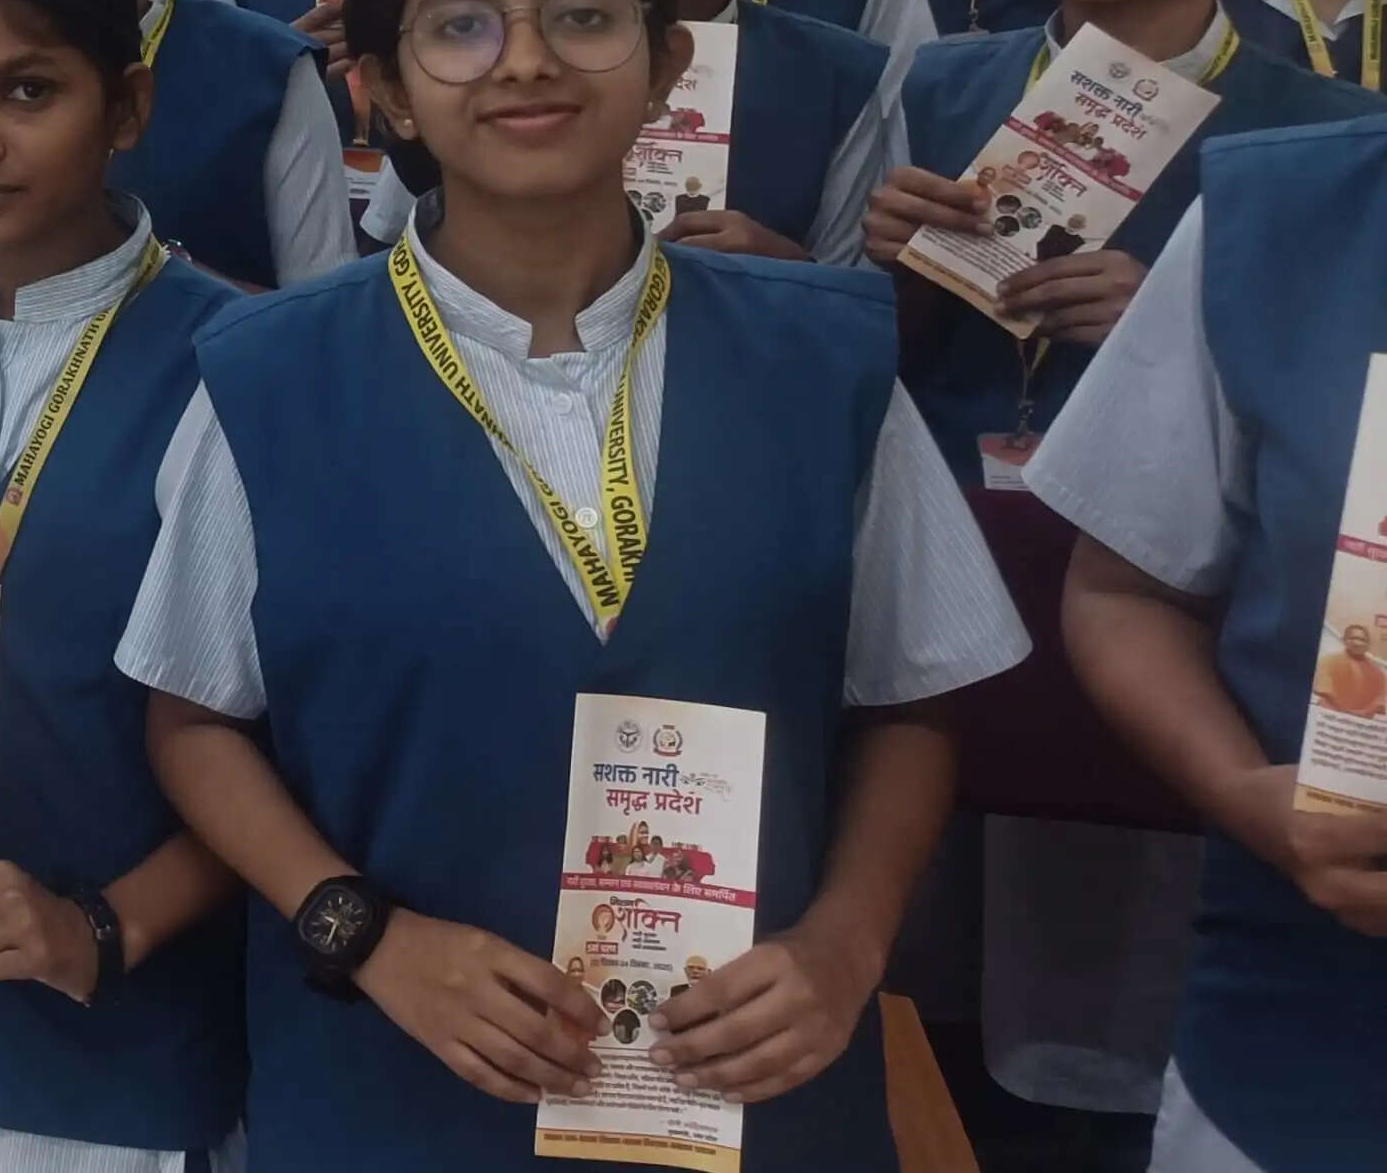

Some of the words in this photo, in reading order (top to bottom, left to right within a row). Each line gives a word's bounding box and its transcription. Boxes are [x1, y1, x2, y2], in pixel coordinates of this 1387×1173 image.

[1070, 71, 1114, 102] सशक्त
[1112, 93, 1144, 119] नारी
[402, 272, 458, 381] UNIVERSITY,
[14, 415, 54, 486] MAHAYOGI
[48, 322, 101, 415] GORAKHNATH
[550, 501, 620, 607] MAHAYOGI
[593, 763, 638, 783] सशक्त
[642, 763, 680, 787] नारी
[606, 789, 649, 815] समृद्ध
[654, 789, 703, 814] प्रदेश
